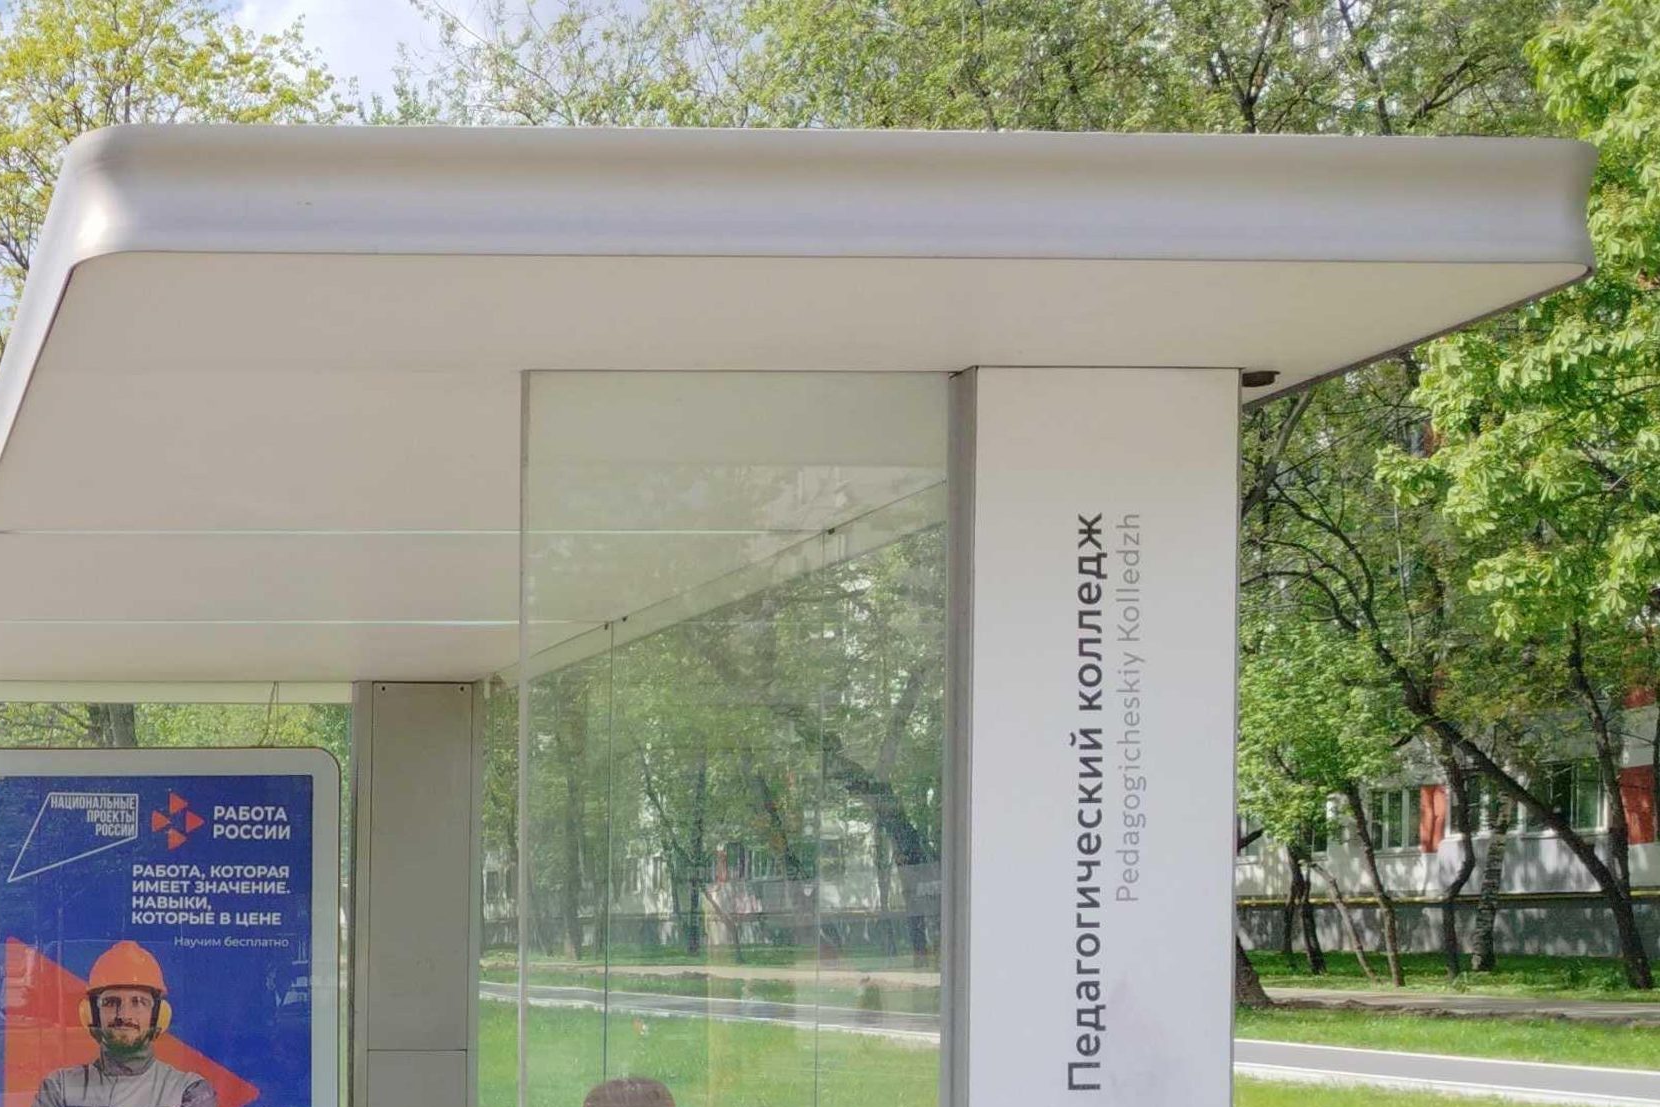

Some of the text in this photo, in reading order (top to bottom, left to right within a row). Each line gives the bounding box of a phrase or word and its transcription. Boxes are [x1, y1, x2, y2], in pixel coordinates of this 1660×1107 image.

[1115, 513, 1147, 903] Pedagogicheskiy Kolledzh
[50, 796, 135, 810] НАЦИОНАЛЬНЫЕ
[1067, 513, 1107, 1092] Педагогический колледж
[86, 810, 135, 823] ПРОЕКТЫ
[213, 805, 288, 821] РАБОТА
[95, 823, 135, 836] РОССИИ
[213, 823, 292, 840] РОССИИ
[132, 864, 290, 880] РАБОТА, КОТОРАЯ
[132, 880, 291, 894] ИМЕЕТ ЗНАЧЕНИЕ.
[132, 896, 212, 911] НАВЫКИ,
[131, 911, 282, 928] КОТОРЫЕ В ЦЕНЕ
[174, 936, 290, 949] Научим бесплатно
